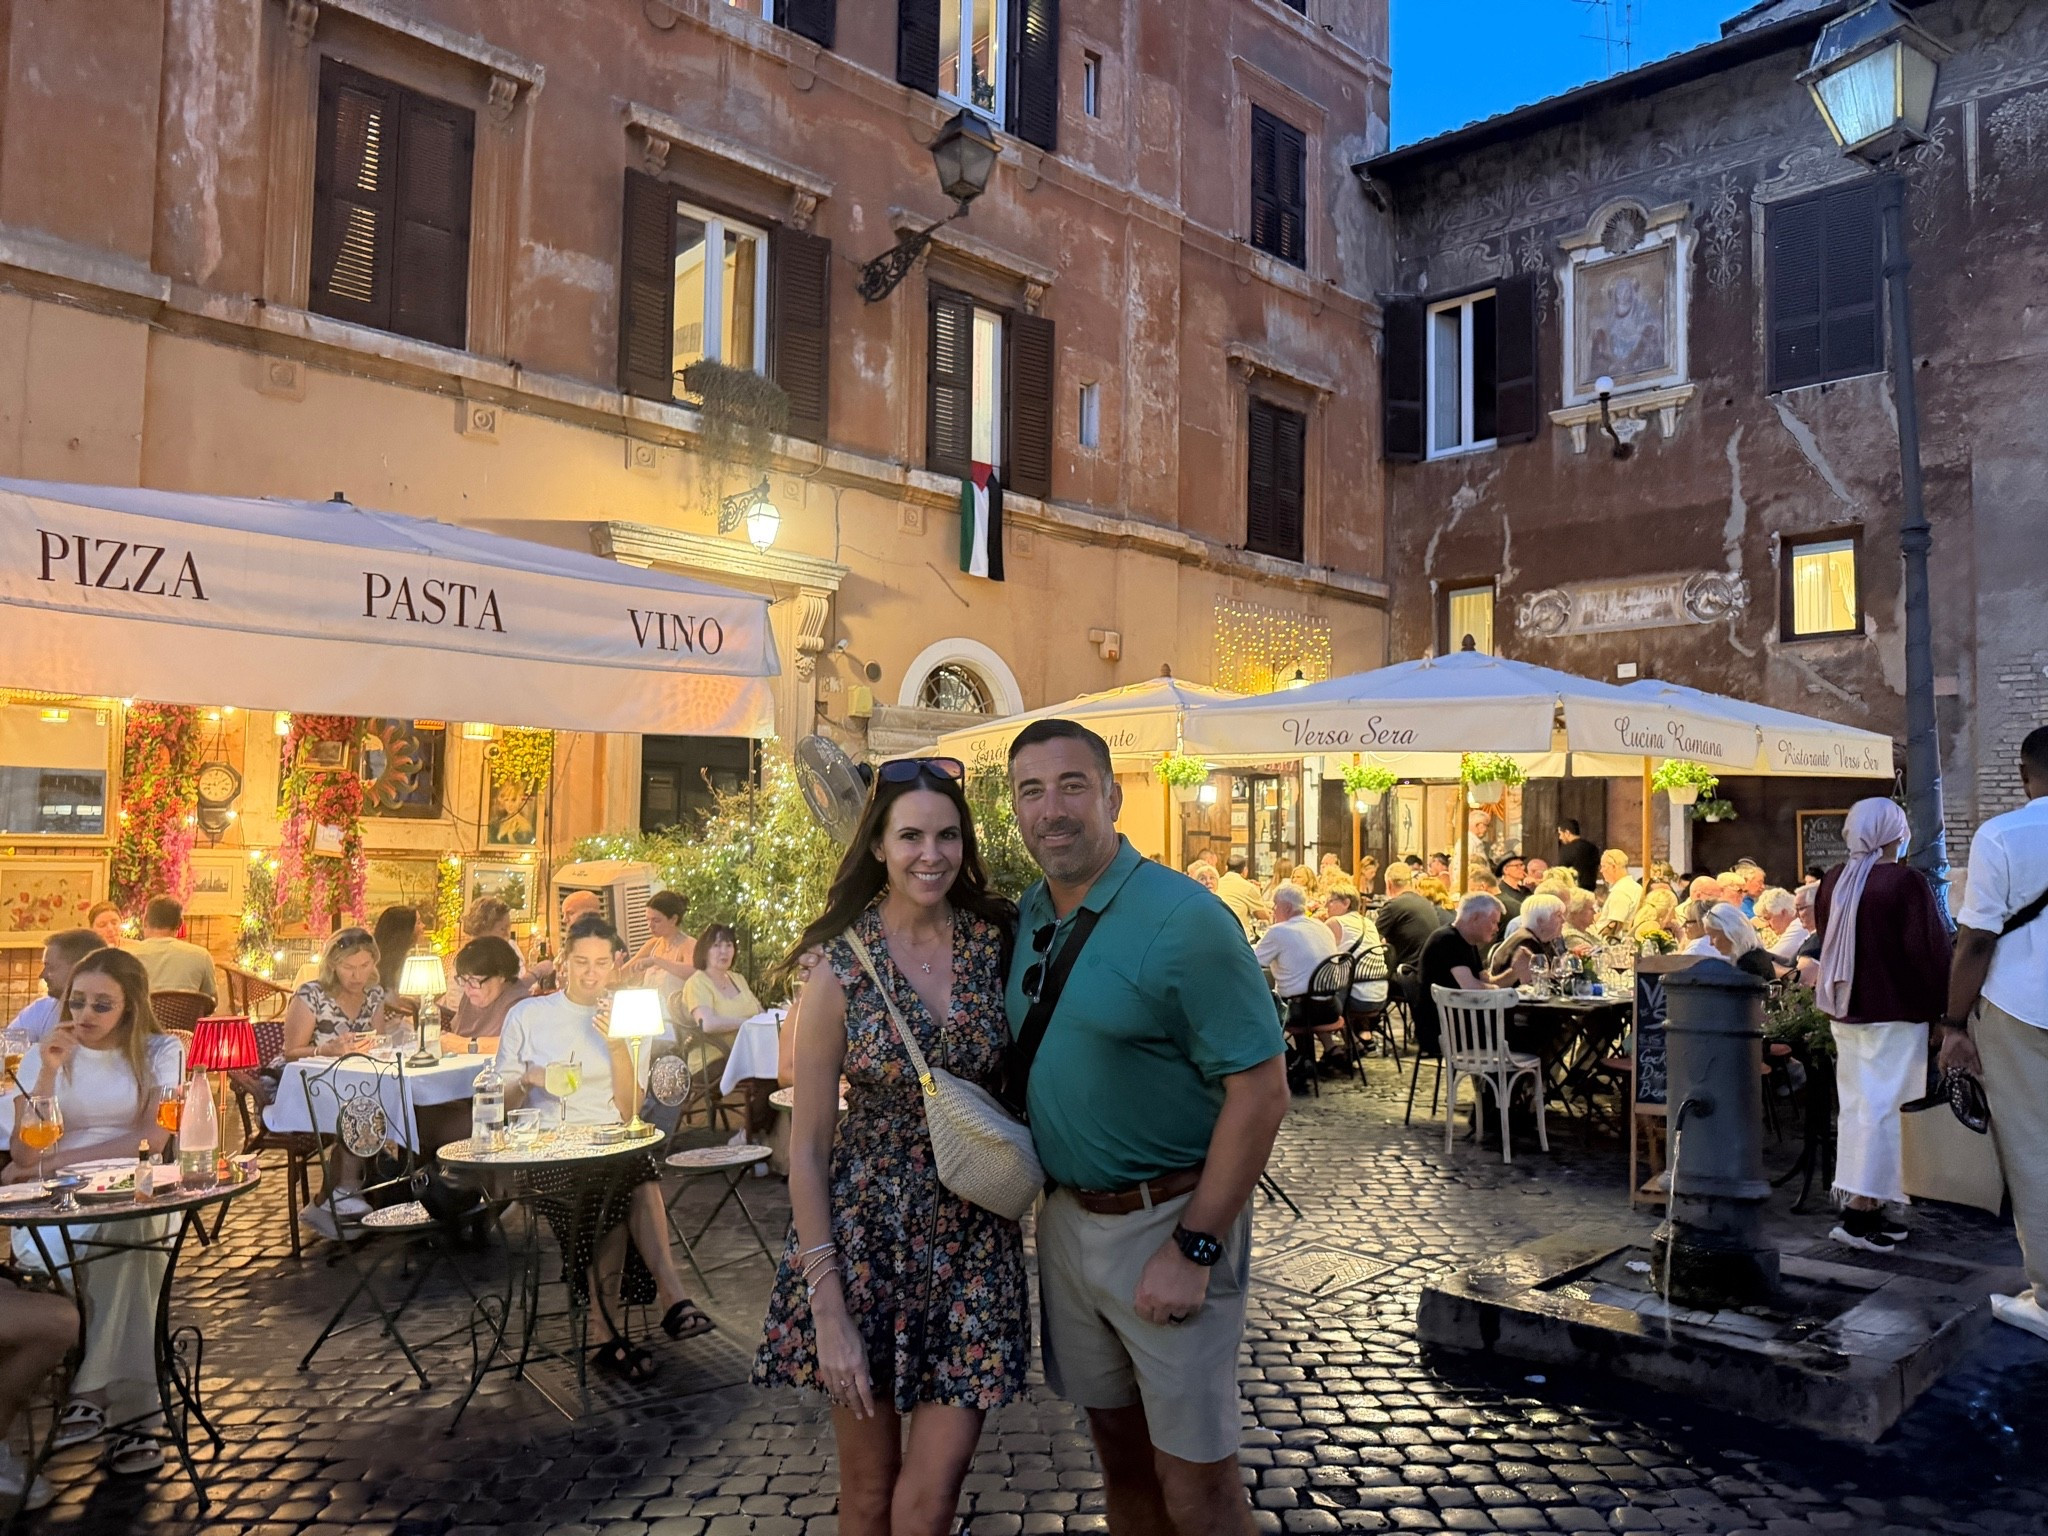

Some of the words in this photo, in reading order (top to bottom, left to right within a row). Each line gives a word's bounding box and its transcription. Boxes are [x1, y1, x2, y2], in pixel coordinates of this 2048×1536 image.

[36, 528, 209, 600] PIZZA
[362, 571, 507, 633] PASTA
[626, 608, 724, 655] VINO
[1282, 717, 1354, 747] Verso
[1360, 715, 1419, 745] Sera
[1614, 715, 1664, 750] Cucina
[1667, 720, 1723, 758] Romana
[1778, 739, 1830, 767] Ristorante
[1833, 743, 1860, 770] Verso
